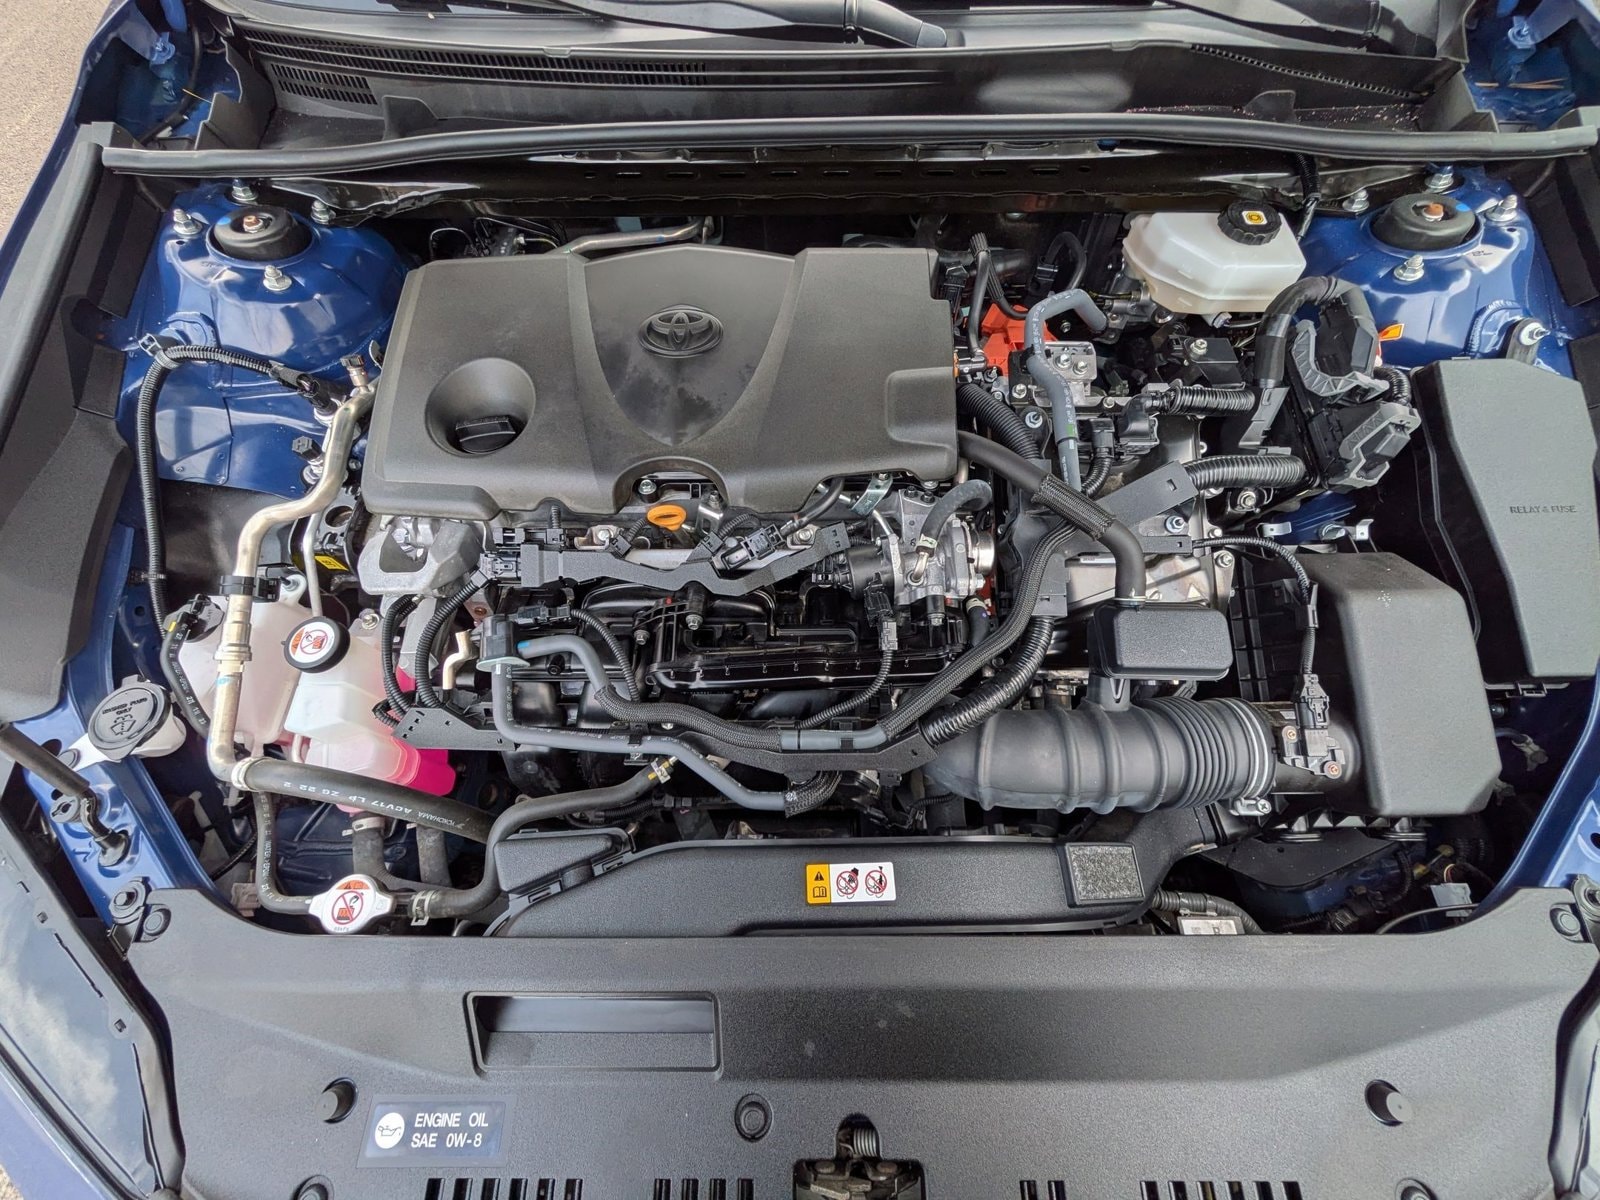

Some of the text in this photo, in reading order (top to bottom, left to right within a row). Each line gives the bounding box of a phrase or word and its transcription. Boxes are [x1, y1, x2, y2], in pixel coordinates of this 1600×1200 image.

[1509, 505, 1541, 514] RELAY
[1551, 505, 1577, 513] FUSE
[417, 811, 456, 827] YOKOHAMA
[414, 1112, 489, 1128] ENGINE OIL
[411, 1132, 482, 1148] SAE 0W-8
